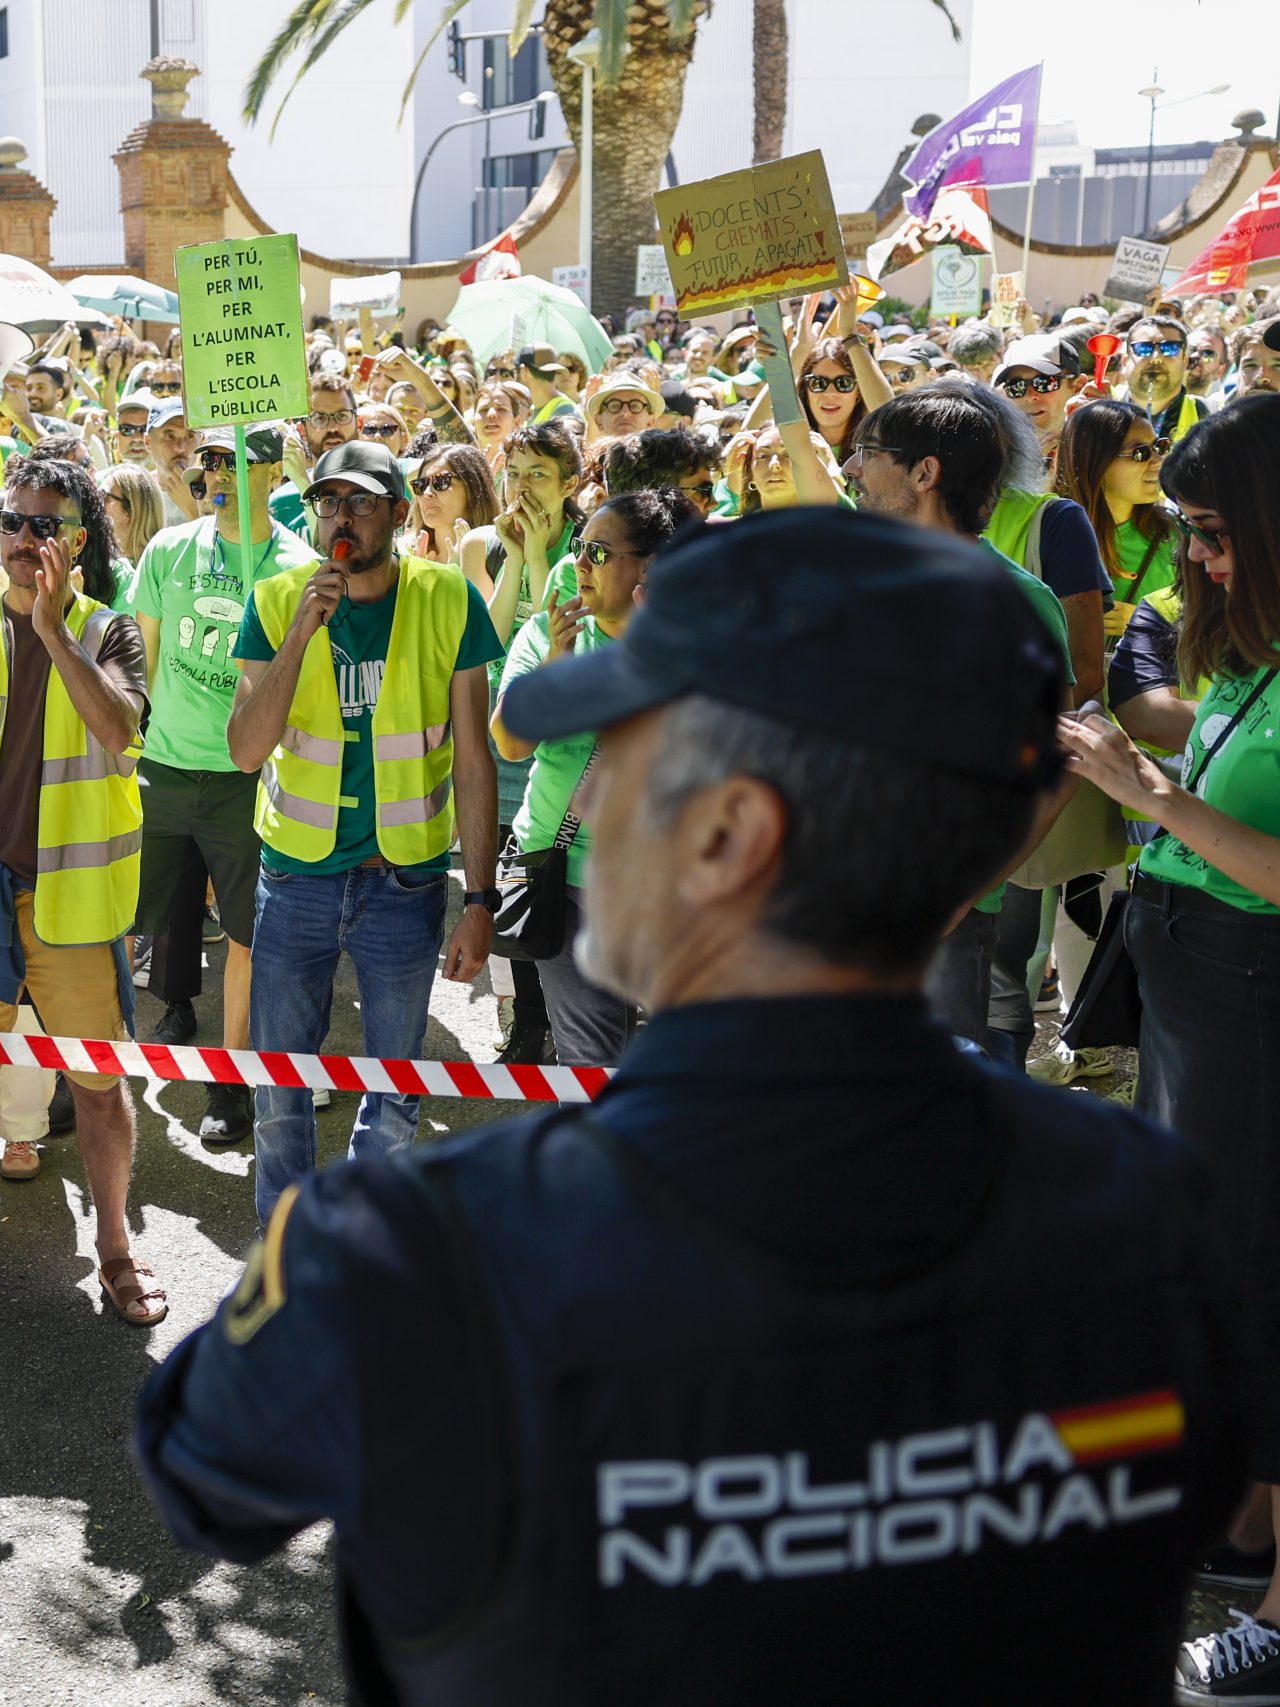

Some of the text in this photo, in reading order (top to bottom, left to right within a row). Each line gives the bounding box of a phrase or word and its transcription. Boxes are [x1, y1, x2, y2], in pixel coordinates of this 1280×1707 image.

[695, 185, 803, 233] DOCENTS
[204, 246, 263, 271] PER TÚ,
[1123, 247, 1160, 264] VAGA
[206, 275, 264, 296] PER MI,
[222, 302, 252, 318] PER
[193, 322, 291, 347] L'ALUMNAT,
[226, 351, 256, 367] PER
[209, 373, 281, 394] L'ESCOLA
[211, 399, 278, 418] PÚBLICA
[600, 1412, 1075, 1524] POLICIA
[601, 1468, 1181, 1586] NACIONAL
